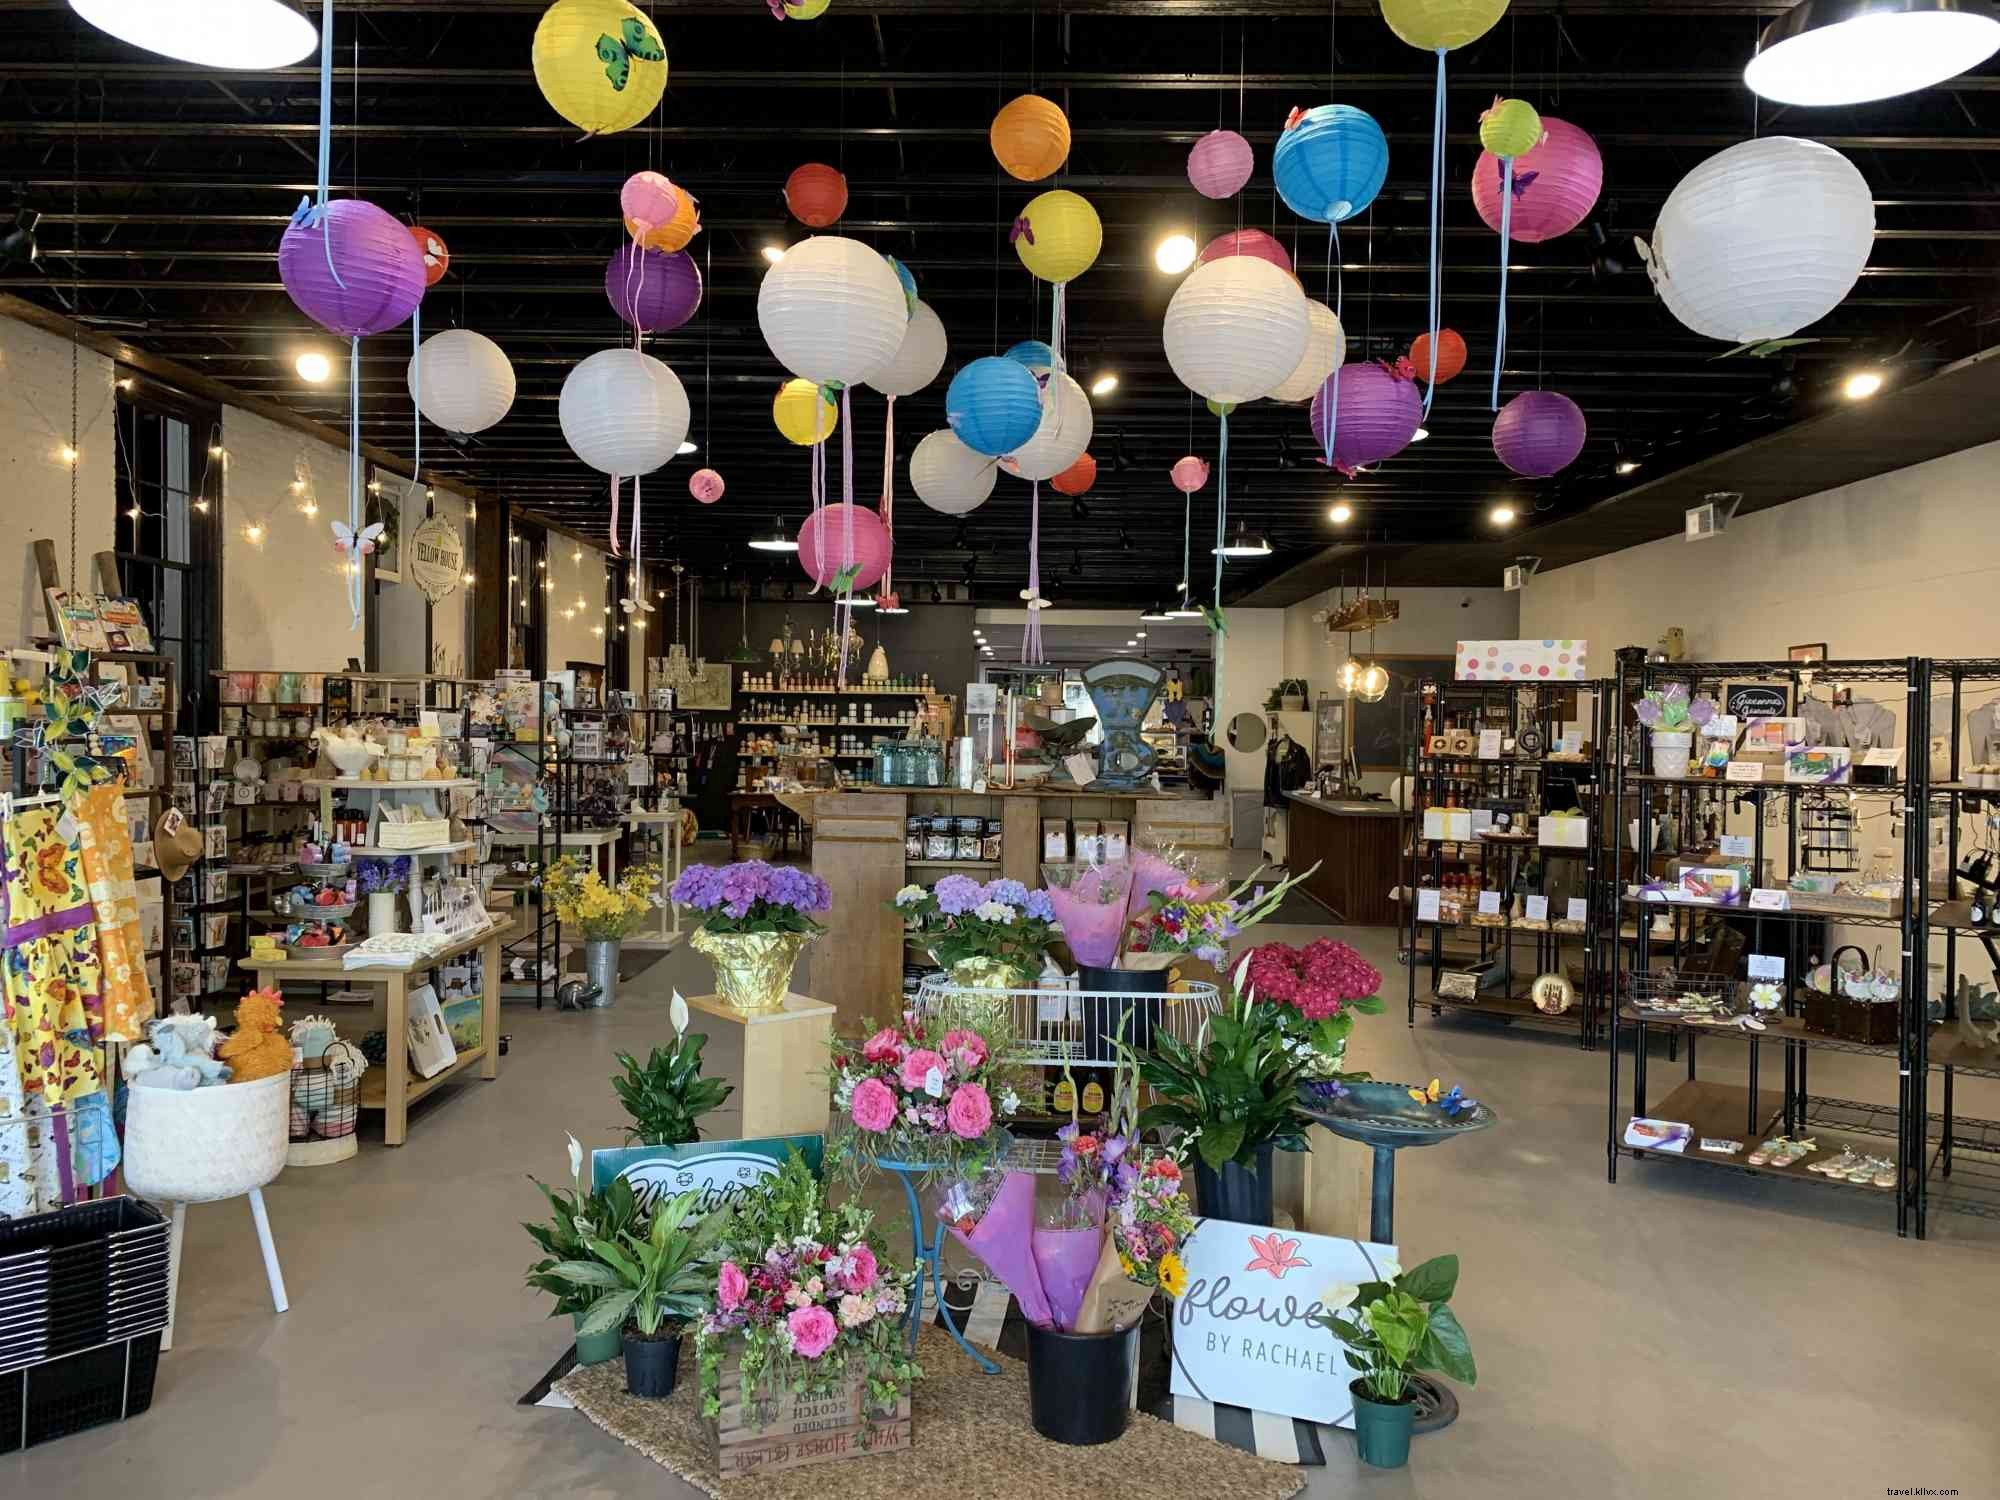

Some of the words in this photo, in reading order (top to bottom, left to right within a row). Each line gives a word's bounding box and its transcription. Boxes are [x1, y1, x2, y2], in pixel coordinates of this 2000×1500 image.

[417, 541, 439, 564] YELLOW
[1206, 1331, 1231, 1354] BY
[1242, 1338, 1338, 1376] RACHAEL
[793, 1401, 847, 1419] SCOTCH
[793, 1416, 850, 1433] BLENDED
[852, 1424, 899, 1448] WHIE
[795, 1432, 849, 1457] HORSE
